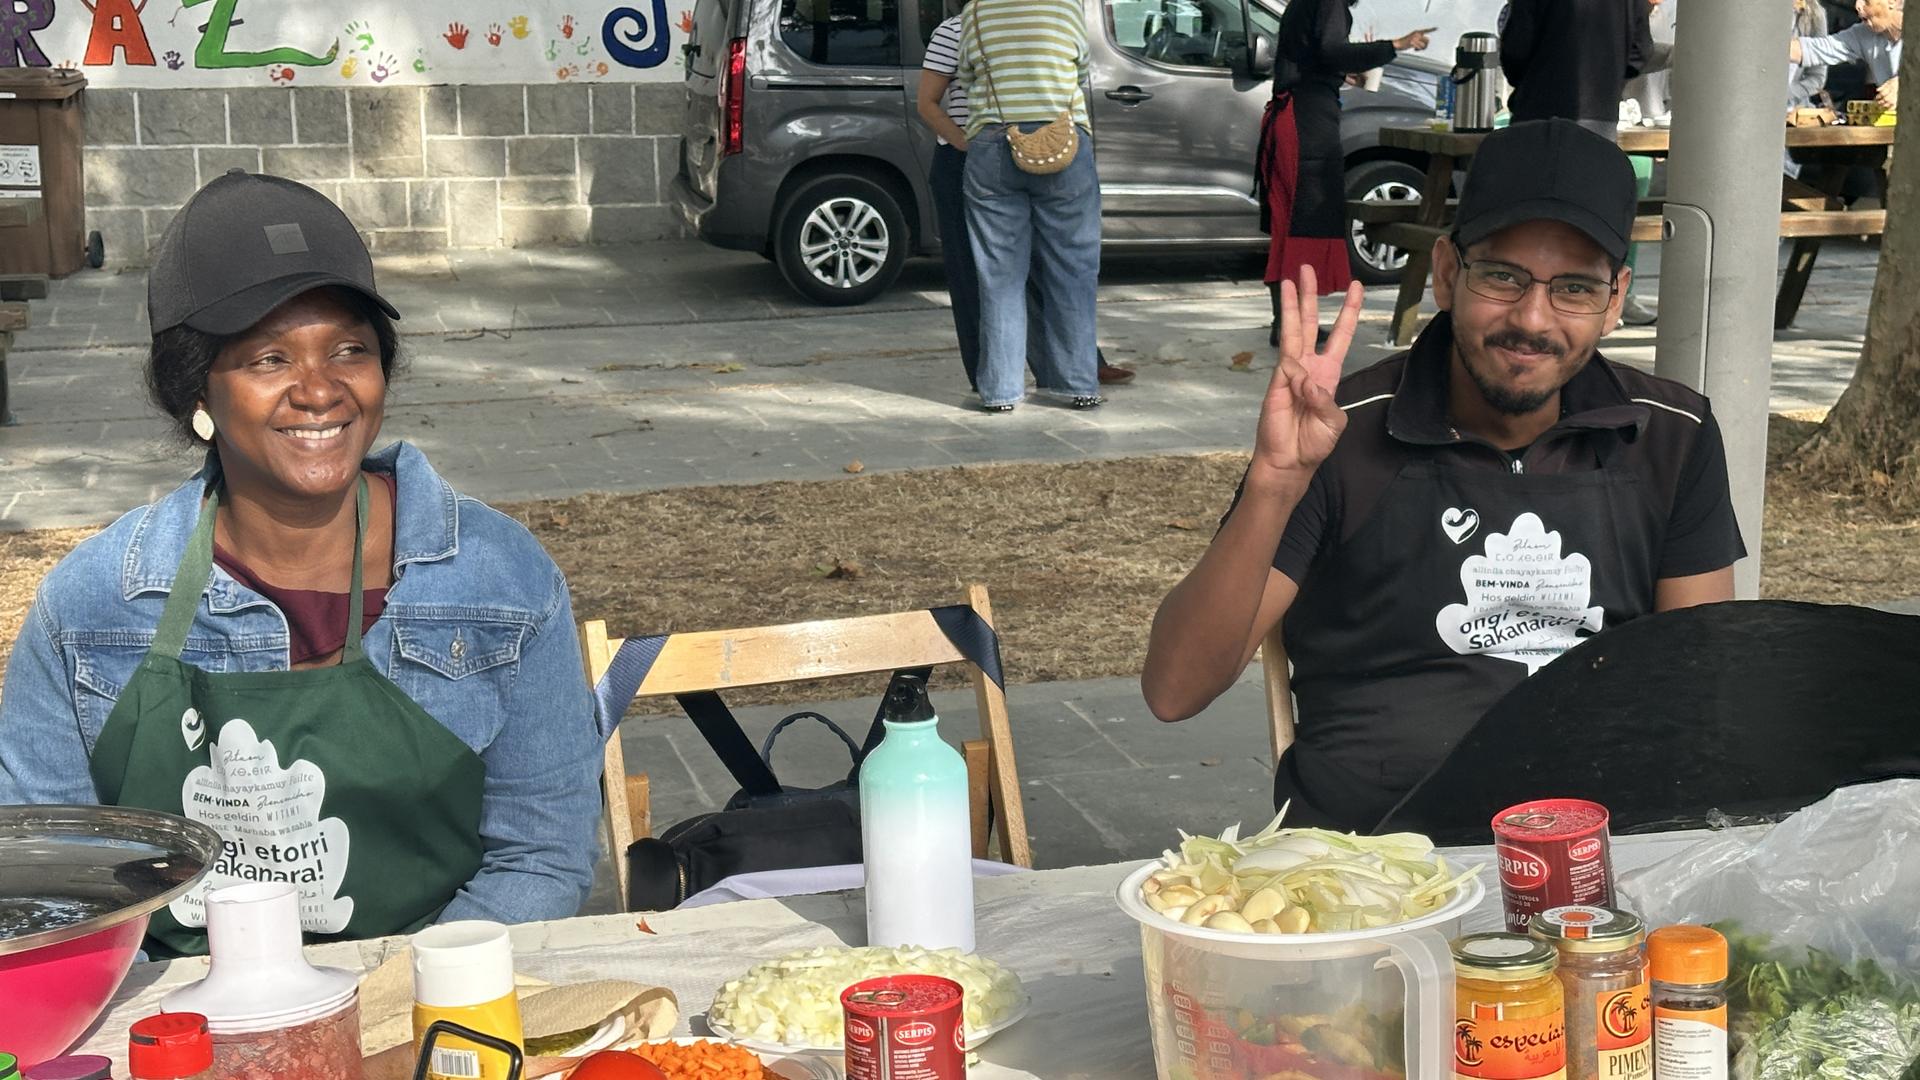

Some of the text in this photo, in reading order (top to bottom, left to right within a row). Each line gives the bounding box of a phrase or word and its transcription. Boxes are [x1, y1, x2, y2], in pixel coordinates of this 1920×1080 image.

[1475, 579, 1530, 589] BEM-VINDA
[1460, 609, 1510, 634] ongi
[193, 792, 249, 808] BEM-VINDA
[223, 810, 260, 823] geldin
[223, 832, 328, 863] gi etorri
[1572, 842, 1599, 857] SERPIS
[209, 855, 324, 884] akanara!
[1499, 855, 1540, 877] ERPIS
[898, 1027, 933, 1039] SERPIS
